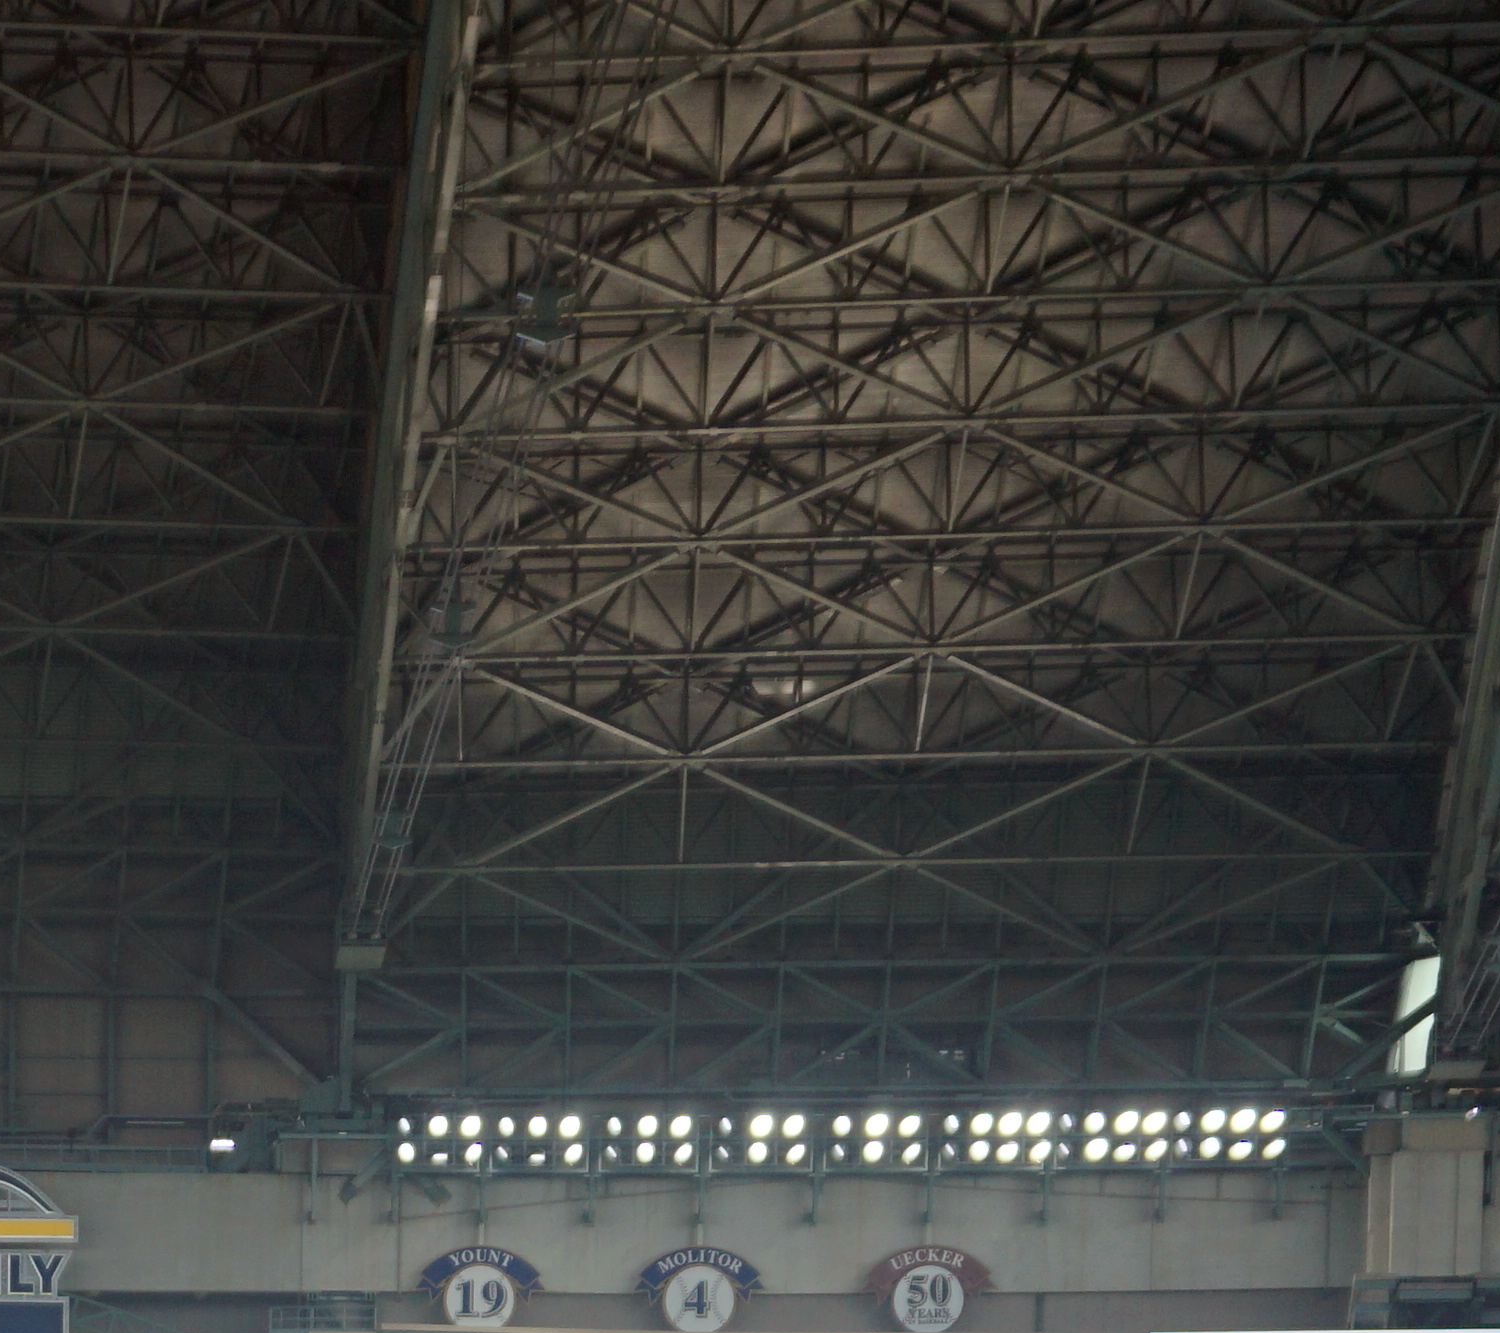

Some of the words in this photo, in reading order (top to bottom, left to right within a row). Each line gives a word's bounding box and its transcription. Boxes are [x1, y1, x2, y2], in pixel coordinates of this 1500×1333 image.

[448, 1247, 514, 1267] YOUNT
[658, 1248, 743, 1274] MOLITOR
[889, 1247, 965, 1268] UECKER
[454, 1280, 505, 1319] 19
[683, 1281, 713, 1318] 4
[906, 1275, 951, 1308] 50
